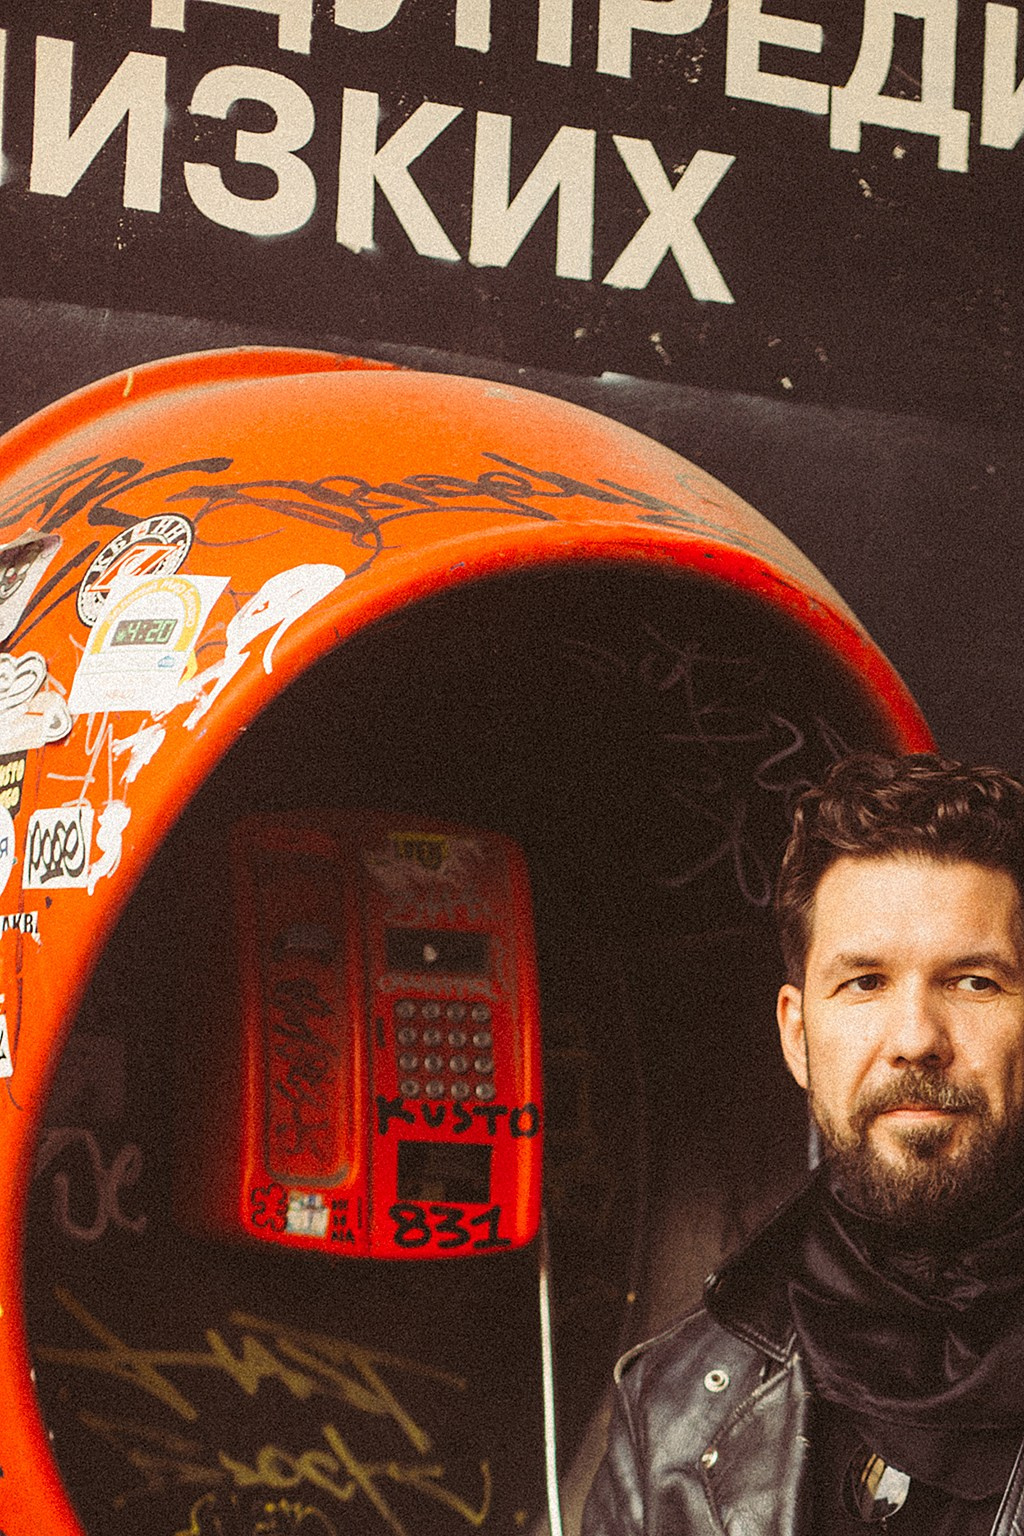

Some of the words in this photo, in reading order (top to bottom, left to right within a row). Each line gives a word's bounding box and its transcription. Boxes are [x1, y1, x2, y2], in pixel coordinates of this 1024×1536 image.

[0, 28, 736, 304] ИЗКИХ
[127, 618, 177, 644] 4:20
[376, 1095, 540, 1138] KUSTO
[388, 1203, 511, 1249] 831
